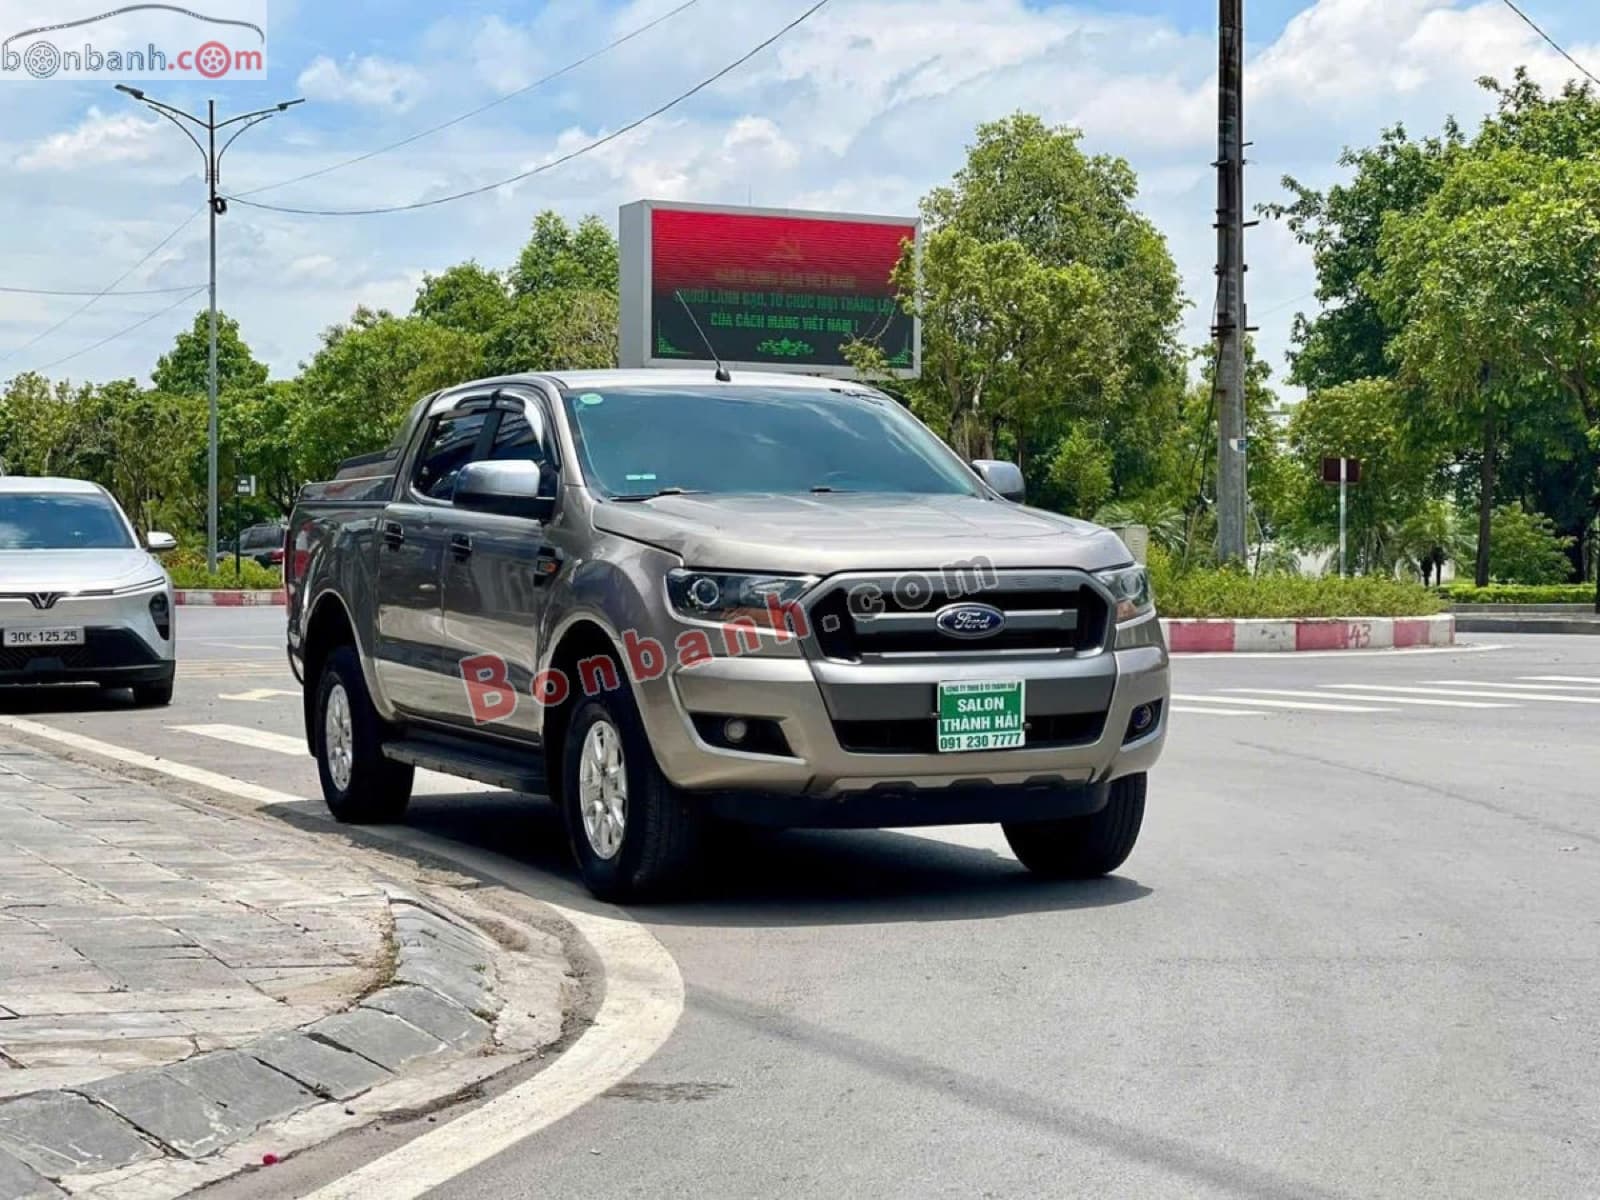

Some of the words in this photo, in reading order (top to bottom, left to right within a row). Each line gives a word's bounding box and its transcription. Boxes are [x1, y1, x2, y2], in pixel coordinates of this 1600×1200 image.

[954, 611, 991, 629] Ford
[1347, 624, 1372, 648] 43
[957, 696, 1005, 713] SALON
[943, 714, 991, 732] THÀNH
[994, 710, 1019, 729] HẢI
[940, 736, 961, 749] 091
[966, 735, 989, 748] 230
[991, 733, 1021, 746] 7777
